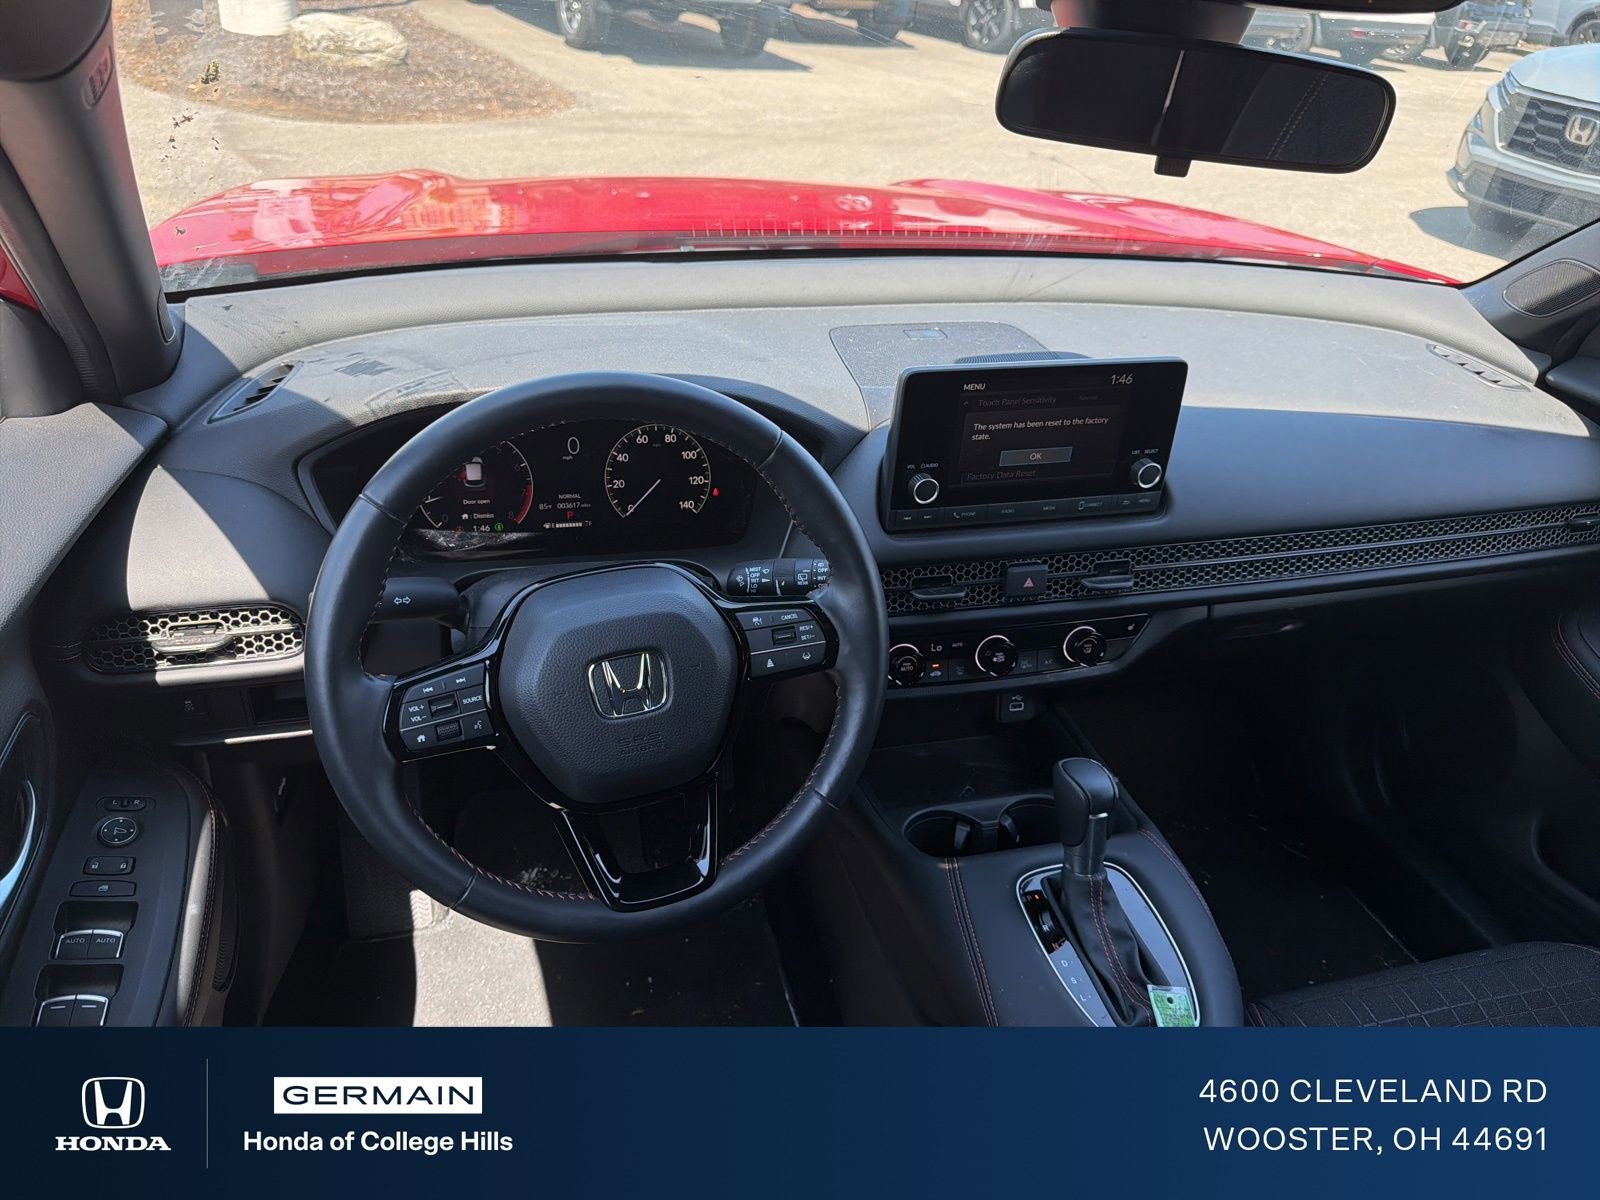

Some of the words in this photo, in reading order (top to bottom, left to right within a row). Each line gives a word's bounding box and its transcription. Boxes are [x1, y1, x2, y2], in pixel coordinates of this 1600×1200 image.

[1111, 373, 1133, 385] 1:46
[963, 383, 986, 391] MENU
[978, 399, 1000, 407] Touch
[974, 423, 987, 431] The
[988, 422, 1013, 434] system
[1013, 421, 1026, 429] has
[1027, 420, 1044, 428] been
[1045, 419, 1062, 427] reset
[1063, 418, 1071, 426] to
[1085, 416, 1109, 426] factory
[636, 434, 649, 444] 60
[664, 433, 677, 443] 80
[971, 433, 991, 441] state.
[567, 436, 580, 455] 0
[616, 453, 629, 463] 40
[681, 450, 697, 460] 100
[1029, 452, 1043, 461] OK
[688, 475, 704, 485] 120
[967, 471, 996, 481] Factory
[997, 470, 1014, 479] Data
[1015, 469, 1036, 477] Reset
[612, 479, 625, 489] 20
[679, 500, 695, 510] 140
[566, 511, 574, 520] P
[781, 613, 798, 621] CANCEL
[930, 643, 943, 652] Lo
[462, 695, 482, 705] SOURCE
[1080, 994, 1087, 1002] L
